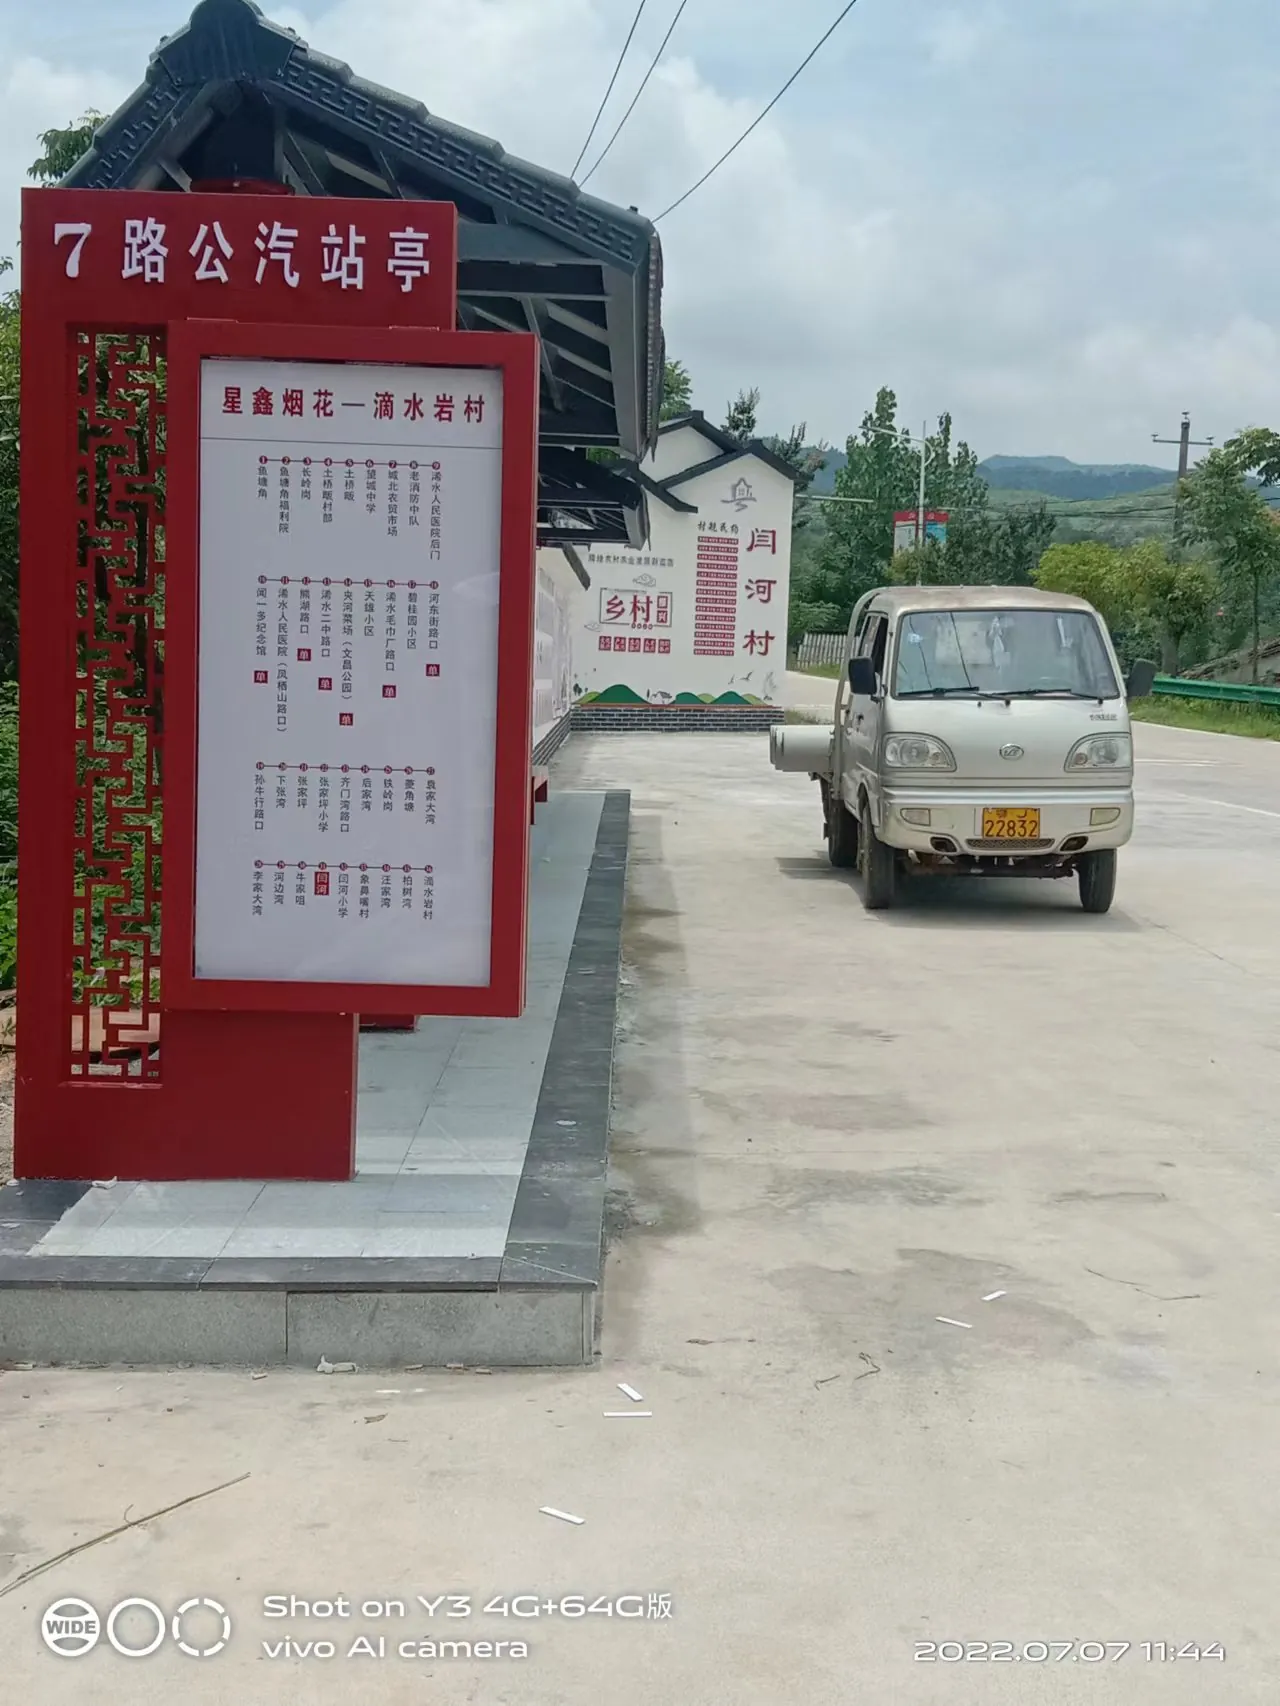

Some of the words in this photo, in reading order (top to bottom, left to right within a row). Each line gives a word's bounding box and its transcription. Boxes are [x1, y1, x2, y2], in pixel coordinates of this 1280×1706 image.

[54, 223, 92, 278] 7
[122, 217, 430, 292] 路公汽站亭
[388, 470, 398, 536] 城北农贸市场
[409, 471, 419, 526] 老消防中队
[430, 472, 441, 560] 浠水人民医院后门
[256, 588, 267, 656] 闻一多纪念馆
[407, 592, 417, 649] 碧桂园小区
[429, 594, 439, 649] 河东街路口
[742, 528, 777, 656] 闫河村
[386, 592, 396, 671] 浠水毛巾厂路口
[985, 820, 1038, 837] 22832
